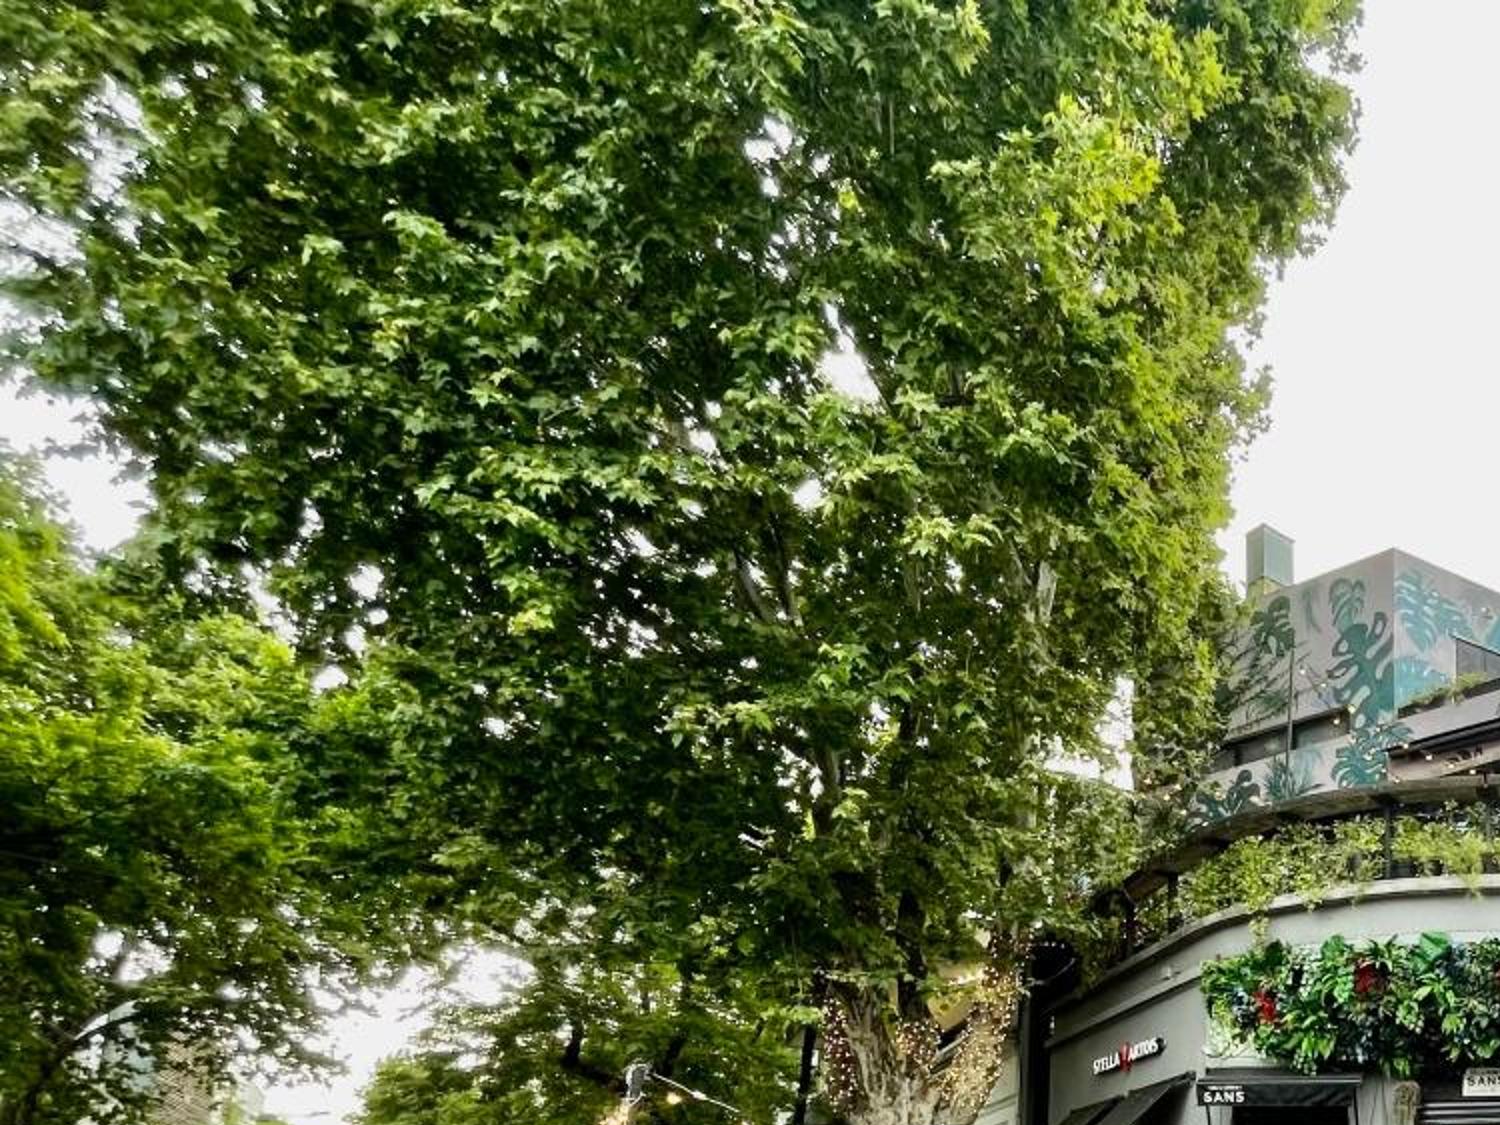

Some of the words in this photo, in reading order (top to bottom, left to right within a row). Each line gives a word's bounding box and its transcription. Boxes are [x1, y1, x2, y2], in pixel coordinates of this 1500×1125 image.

[1093, 1052, 1120, 1075] STELLA
[1127, 1037, 1159, 1062] ARTOIS
[1203, 1091, 1245, 1103] SANS
